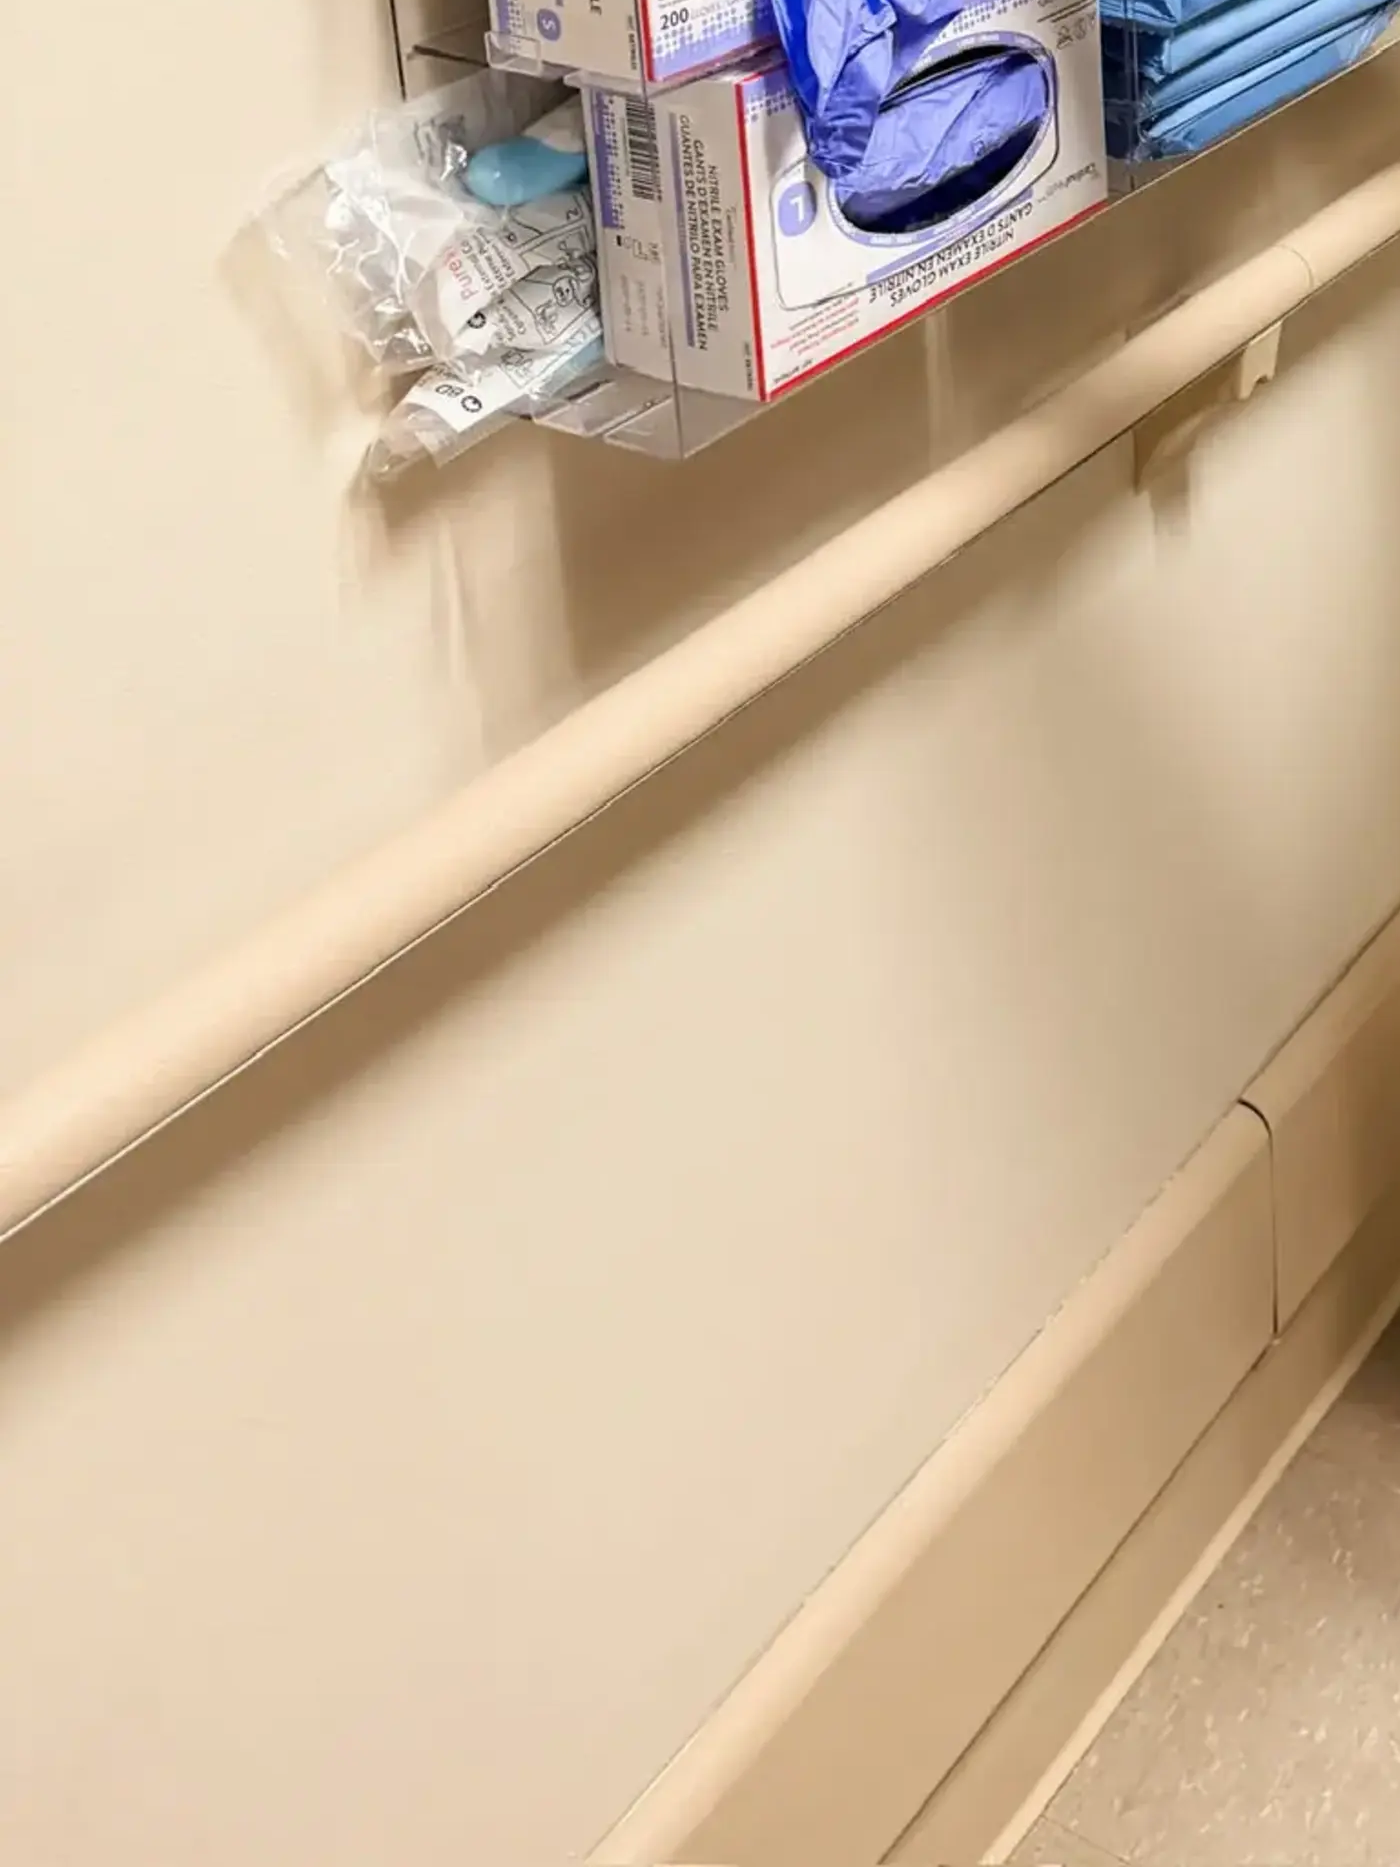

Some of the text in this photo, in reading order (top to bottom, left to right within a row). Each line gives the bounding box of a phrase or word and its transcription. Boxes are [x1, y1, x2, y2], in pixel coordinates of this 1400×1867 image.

[541, 16, 556, 31] S
[660, 7, 689, 30] 200
[693, 139, 706, 183] GANTS
[679, 114, 707, 349] GUANTES DE NITRILO PARA EXAMEN
[994, 204, 1033, 232] GANTS
[706, 164, 729, 311] NITRILE EXAM GLOVES
[703, 260, 713, 277] EN
[886, 227, 1016, 307] NITRILE EXAM GLOVES
[916, 256, 936, 274] EN
[864, 266, 918, 303] NITRILE
[704, 280, 717, 332] NITRILE
